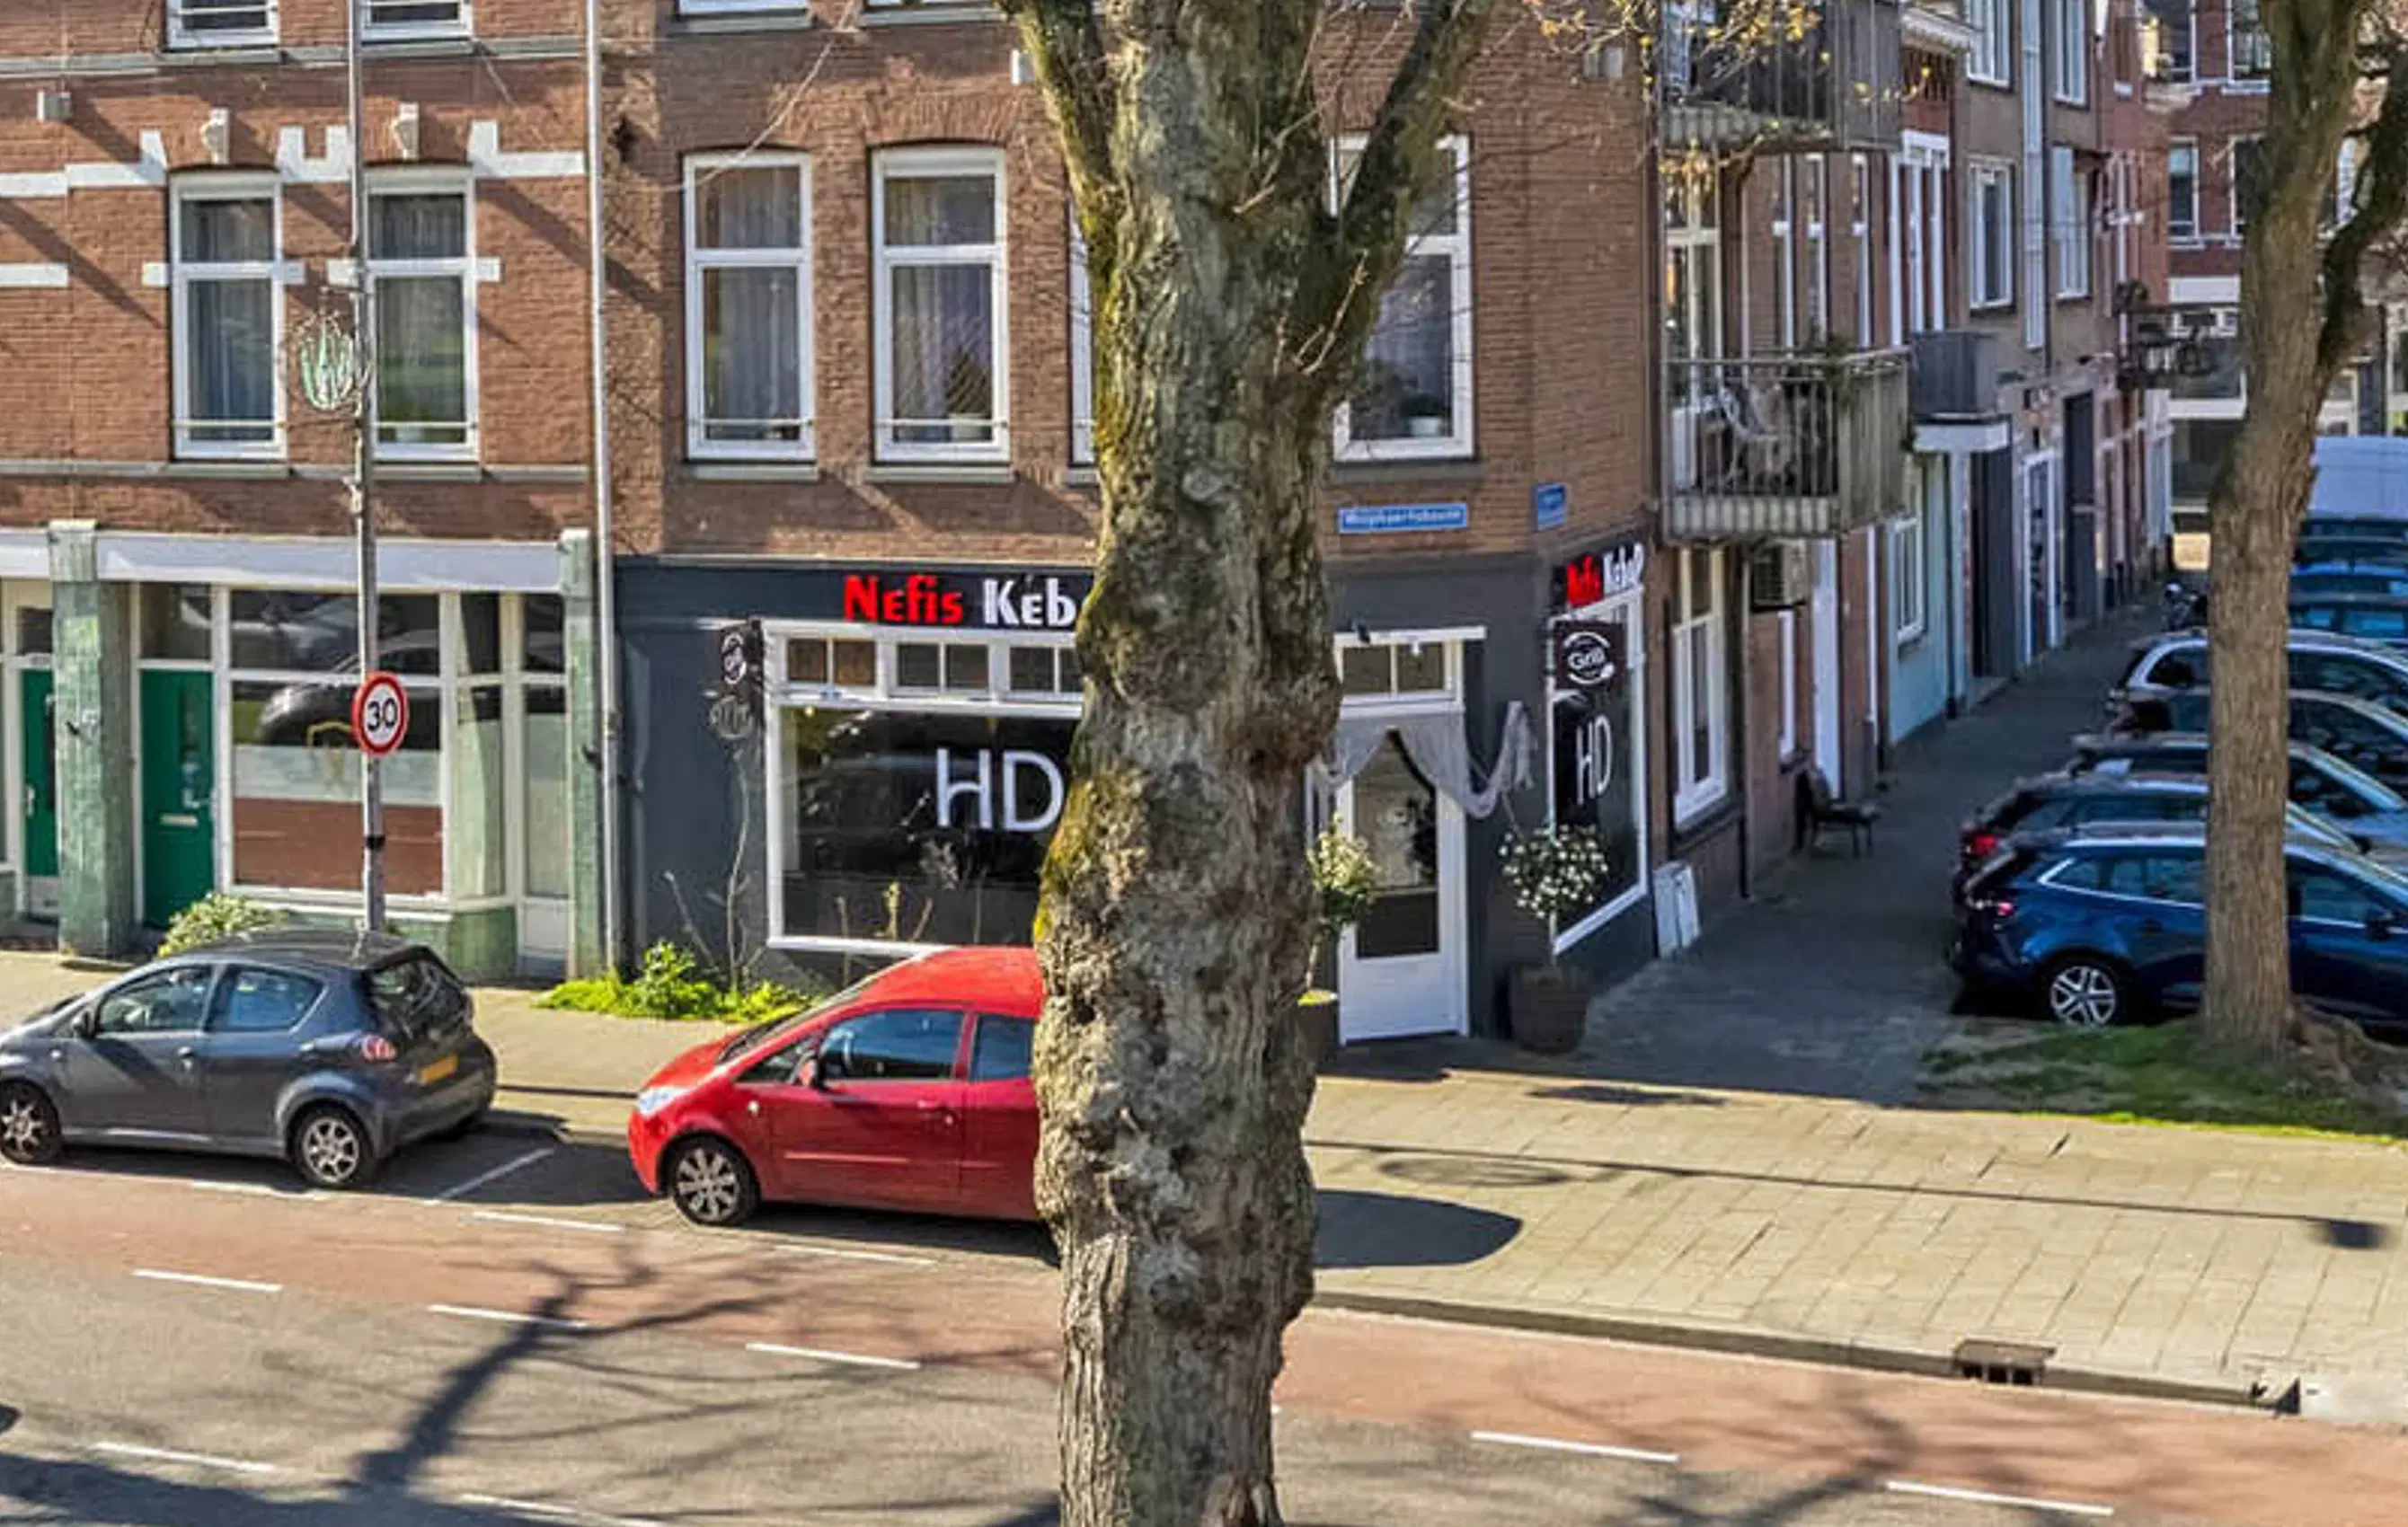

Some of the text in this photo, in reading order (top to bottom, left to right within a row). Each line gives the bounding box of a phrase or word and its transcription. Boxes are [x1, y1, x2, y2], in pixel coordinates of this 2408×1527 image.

[844, 573, 1077, 627] Nefis Keb
[367, 698, 398, 731] 30
[936, 747, 1064, 833] HD
[1576, 715, 1612, 807] HD
